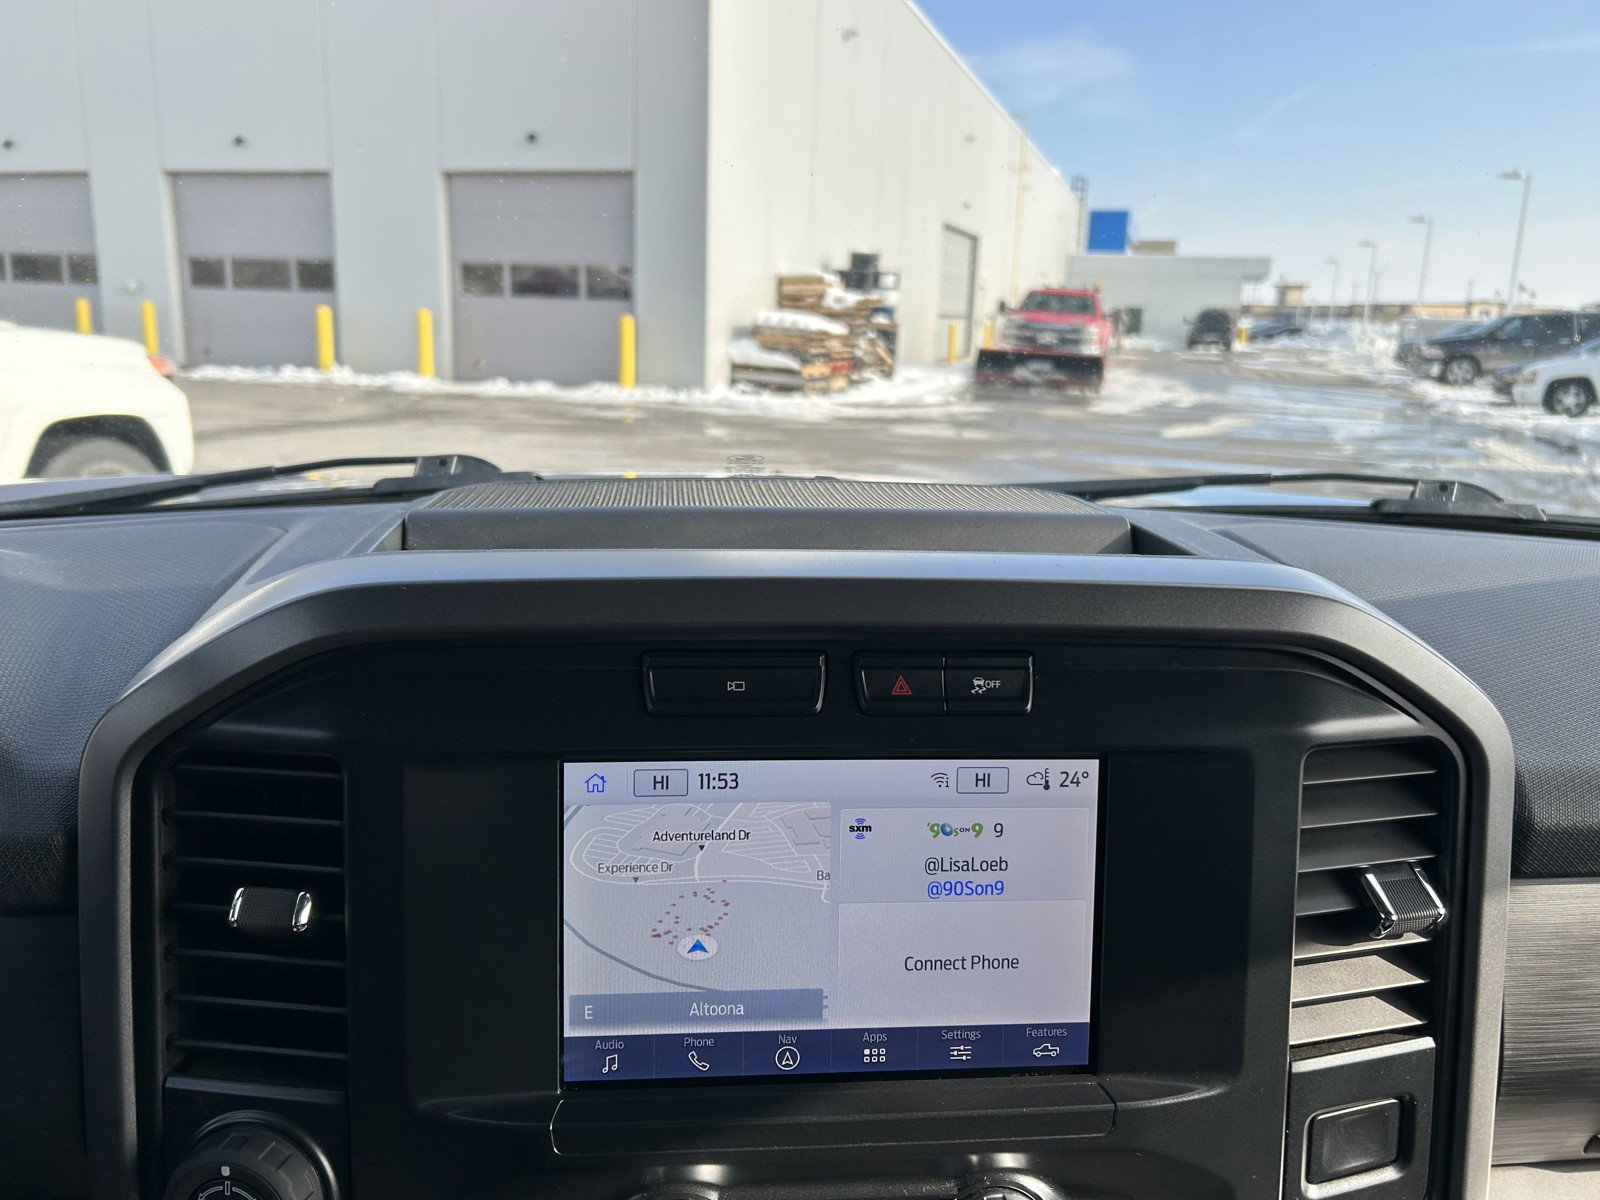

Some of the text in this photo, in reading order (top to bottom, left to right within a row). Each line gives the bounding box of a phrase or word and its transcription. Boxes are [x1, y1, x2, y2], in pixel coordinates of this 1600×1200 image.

[985, 680, 1001, 688] OFF
[652, 775, 670, 791] HI
[697, 772, 740, 790] 11:53
[974, 772, 992, 788] HI
[848, 824, 873, 834] sxm
[993, 823, 1004, 838] 9
[652, 830, 751, 843] Adventureland Dr
[597, 861, 674, 875] Experience Dr
[924, 856, 1009, 876] @LisaLoeb
[926, 880, 1005, 900] @90Son9
[904, 954, 1020, 972] Connect Phone
[584, 1005, 594, 1020] E
[689, 1002, 745, 1017] Altoona
[862, 1031, 888, 1044] Apps
[941, 1029, 982, 1041] Settings
[1026, 1026, 1068, 1038] Features
[594, 1039, 625, 1051] Audio
[683, 1036, 715, 1048] Phone
[778, 1034, 798, 1045] Nav
